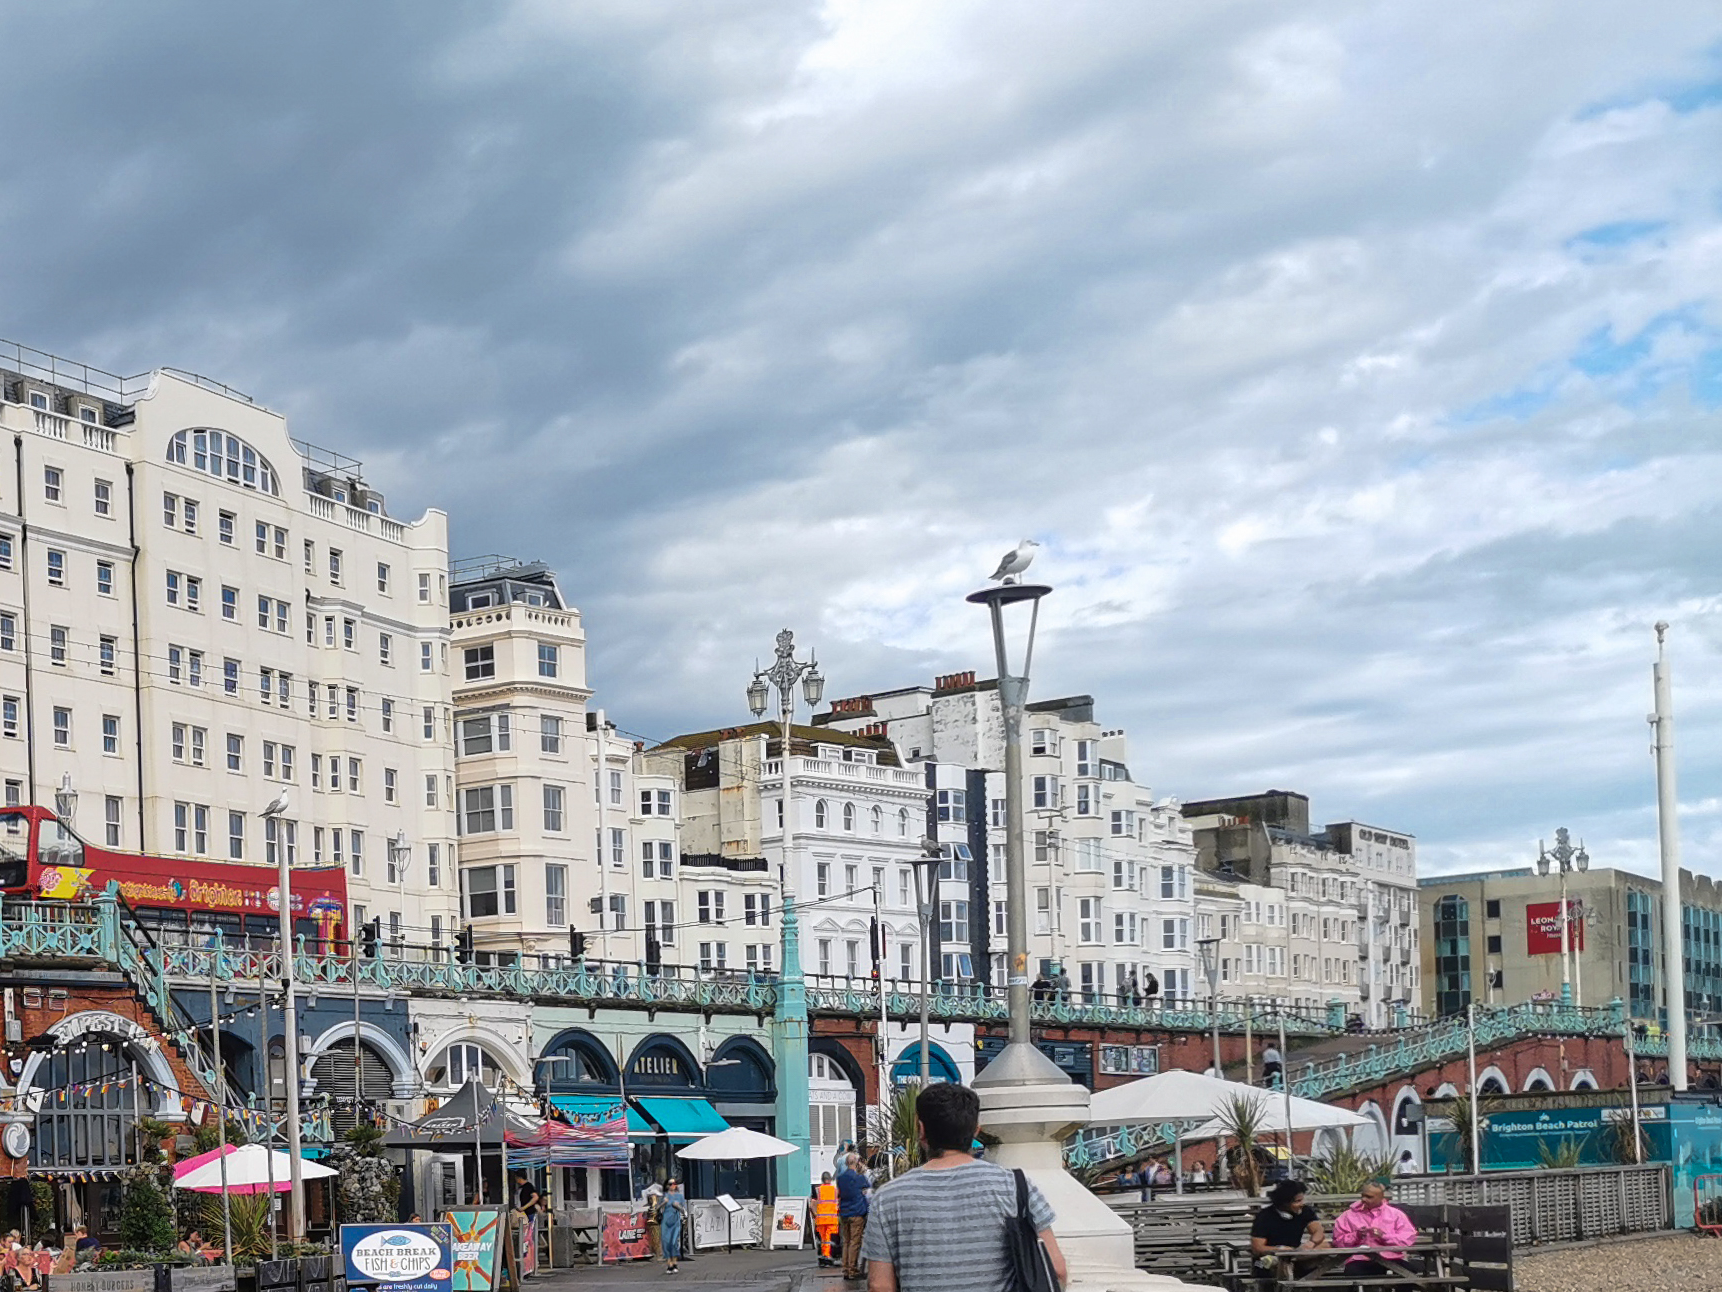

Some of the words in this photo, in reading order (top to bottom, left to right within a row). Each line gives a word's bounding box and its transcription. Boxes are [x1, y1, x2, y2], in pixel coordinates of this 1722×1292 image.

[55, 1014, 123, 1046] EMPEST
[1491, 1122, 1534, 1133] Brighton
[1536, 1121, 1565, 1130] Beach
[1567, 1119, 1598, 1129] Patrol
[705, 1216, 726, 1232] LAZY
[356, 1248, 394, 1257] BEACH
[396, 1247, 436, 1256] BREAK
[452, 1242, 493, 1251] AKEAWAY
[365, 1258, 388, 1271] FISH
[390, 1258, 399, 1269] &
[401, 1257, 431, 1271] CHIPS
[101, 1279, 135, 1291] BURGERS
[393, 1283, 413, 1291] freshly
